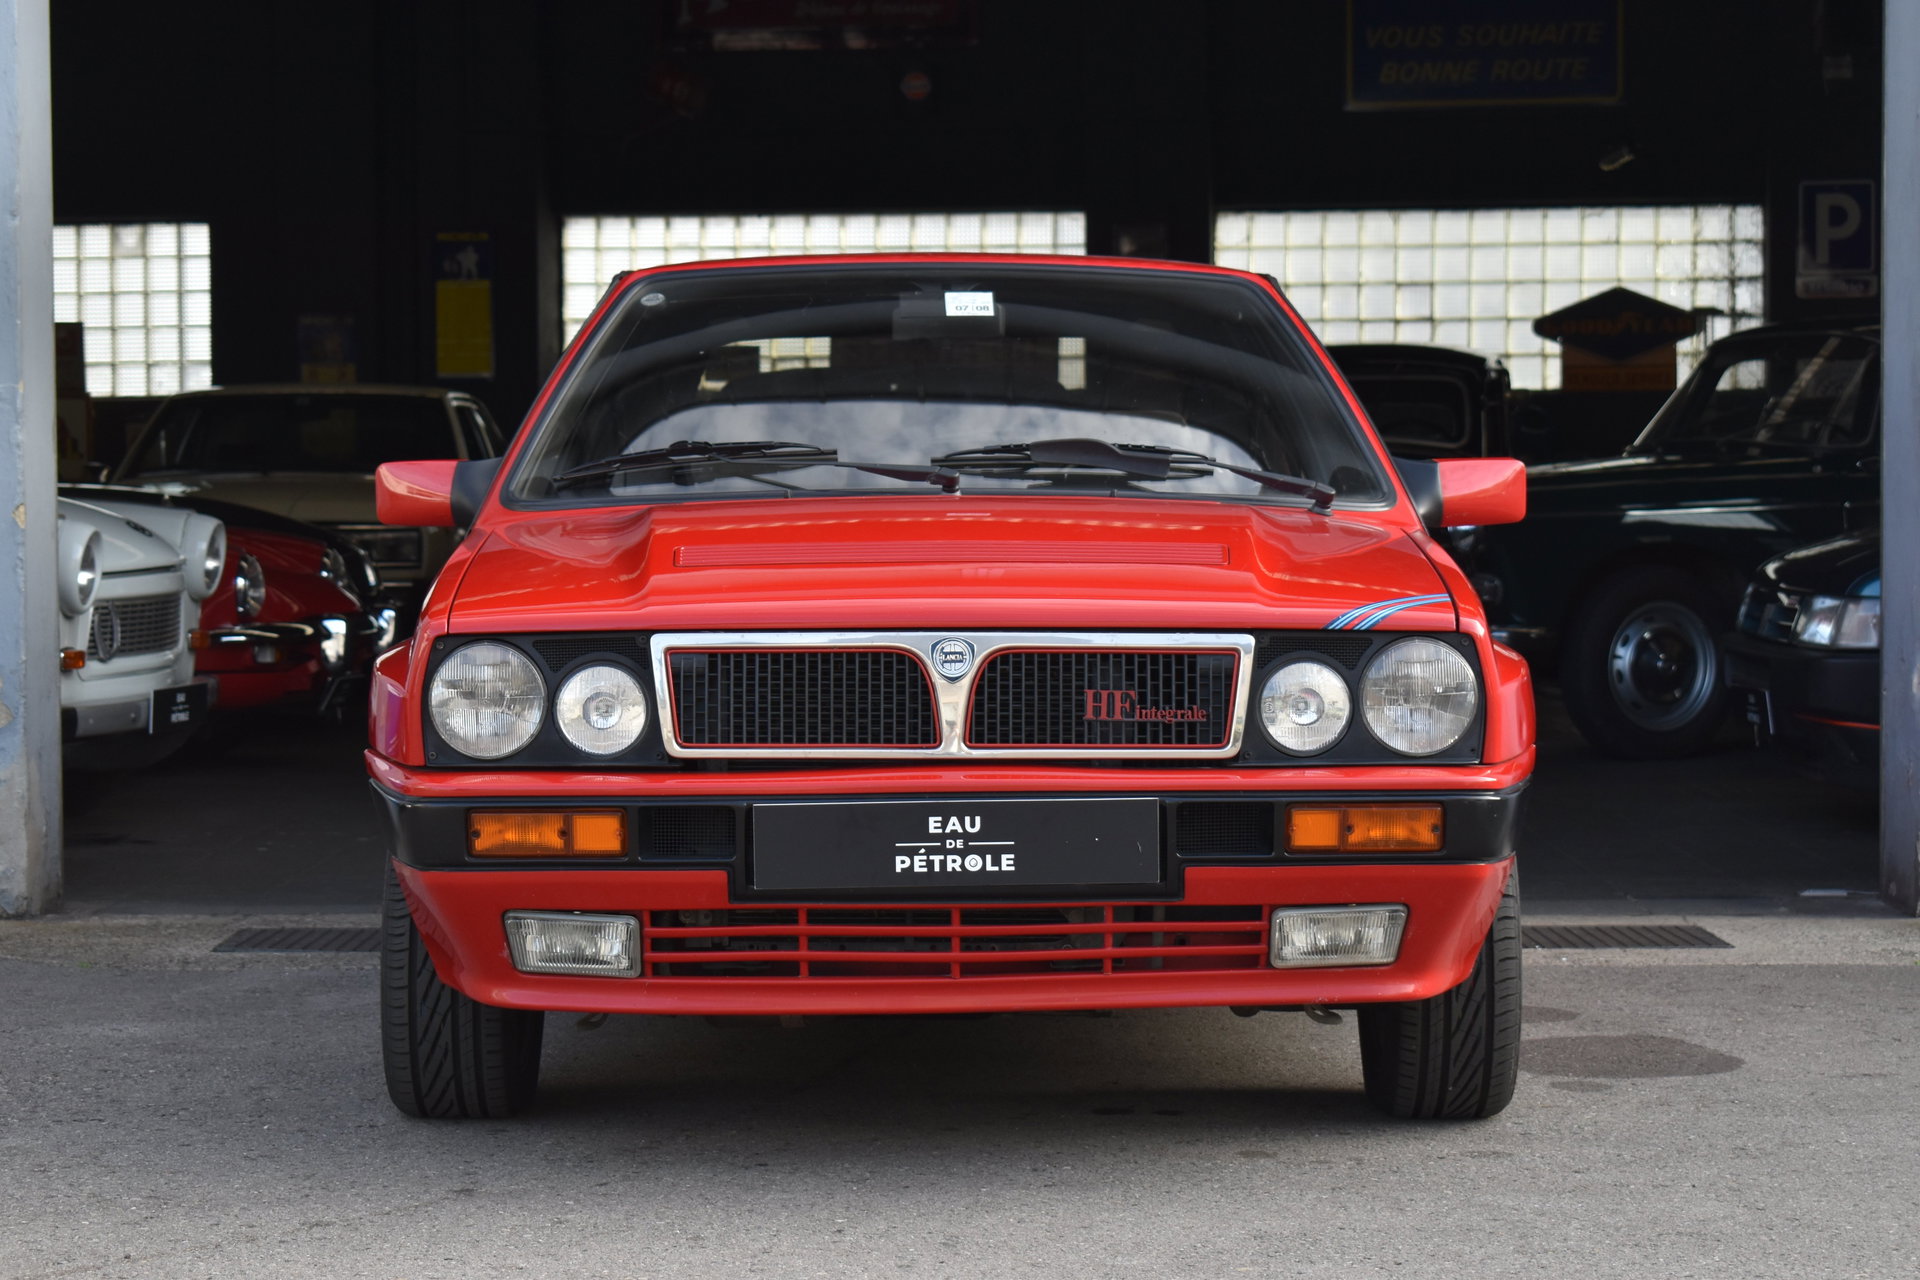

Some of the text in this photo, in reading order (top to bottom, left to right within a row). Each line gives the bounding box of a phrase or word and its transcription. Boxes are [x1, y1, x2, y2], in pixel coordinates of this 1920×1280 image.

[1365, 21, 1605, 48] VOUS SOUHAITE
[1379, 57, 1590, 84] BONNE ROUTE
[1815, 192, 1862, 264] P
[1083, 689, 1207, 723] HF integrale
[928, 816, 981, 833] EAU
[946, 839, 964, 848] DE
[895, 848, 1015, 872] PÉTROLE
